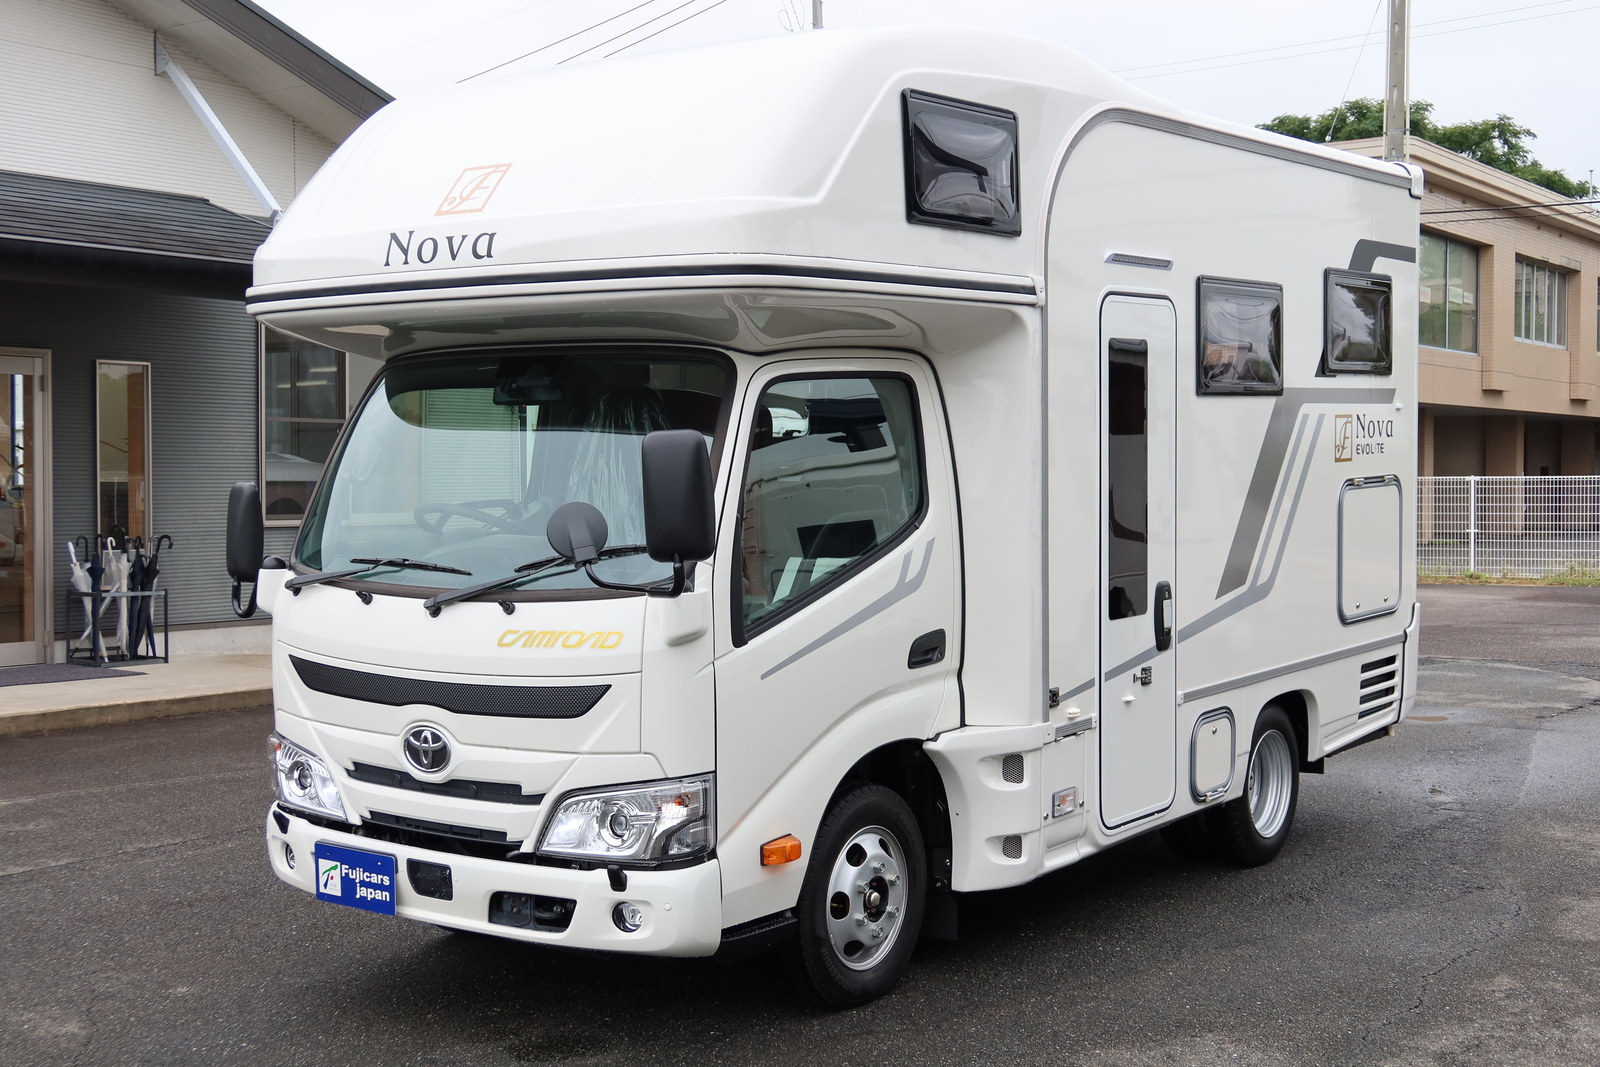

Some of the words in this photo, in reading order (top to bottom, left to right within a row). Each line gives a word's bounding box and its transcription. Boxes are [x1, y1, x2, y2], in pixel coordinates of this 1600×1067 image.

[384, 230, 497, 266] Nova
[1356, 414, 1393, 438] Nova
[341, 864, 390, 886] Fujicars
[355, 883, 390, 902] japan
